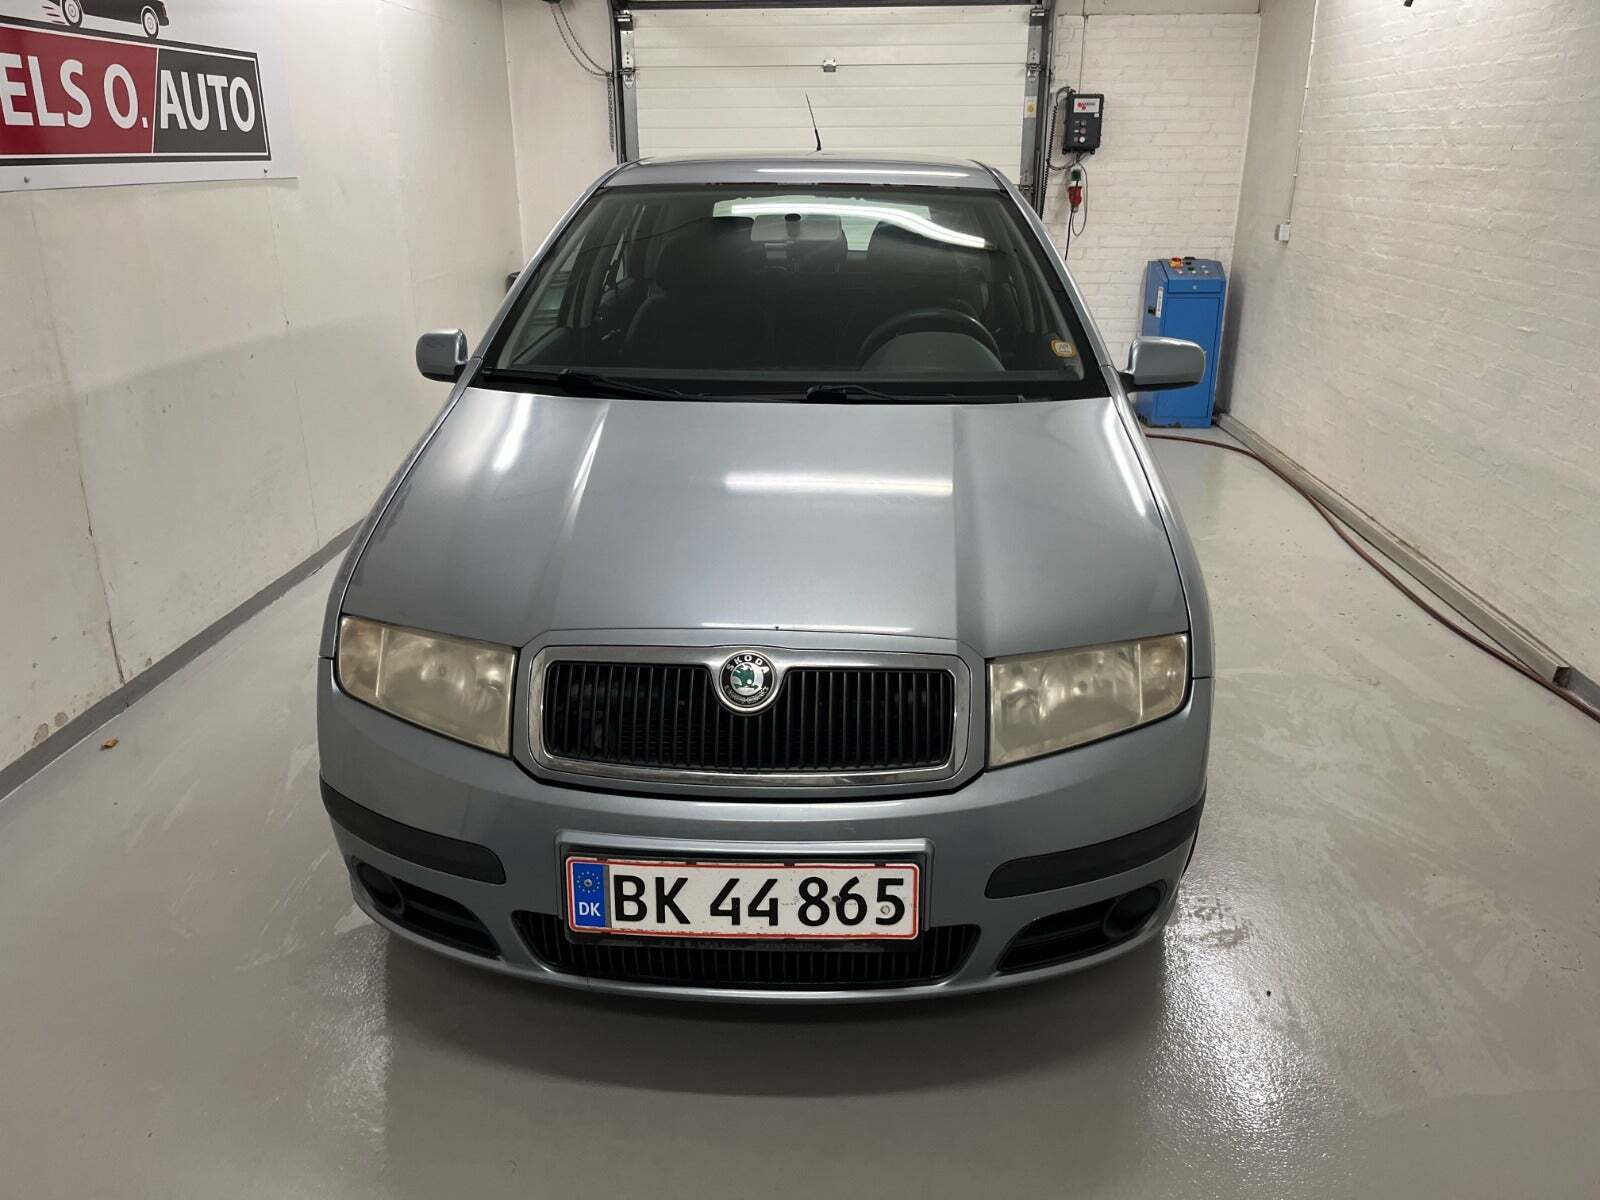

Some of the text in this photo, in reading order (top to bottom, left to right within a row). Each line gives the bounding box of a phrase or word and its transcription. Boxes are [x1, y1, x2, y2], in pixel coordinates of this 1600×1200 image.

[103, 63, 148, 129] O.
[160, 69, 255, 132] AUTO
[579, 902, 600, 917] DK
[613, 874, 905, 927] BK 44 865
